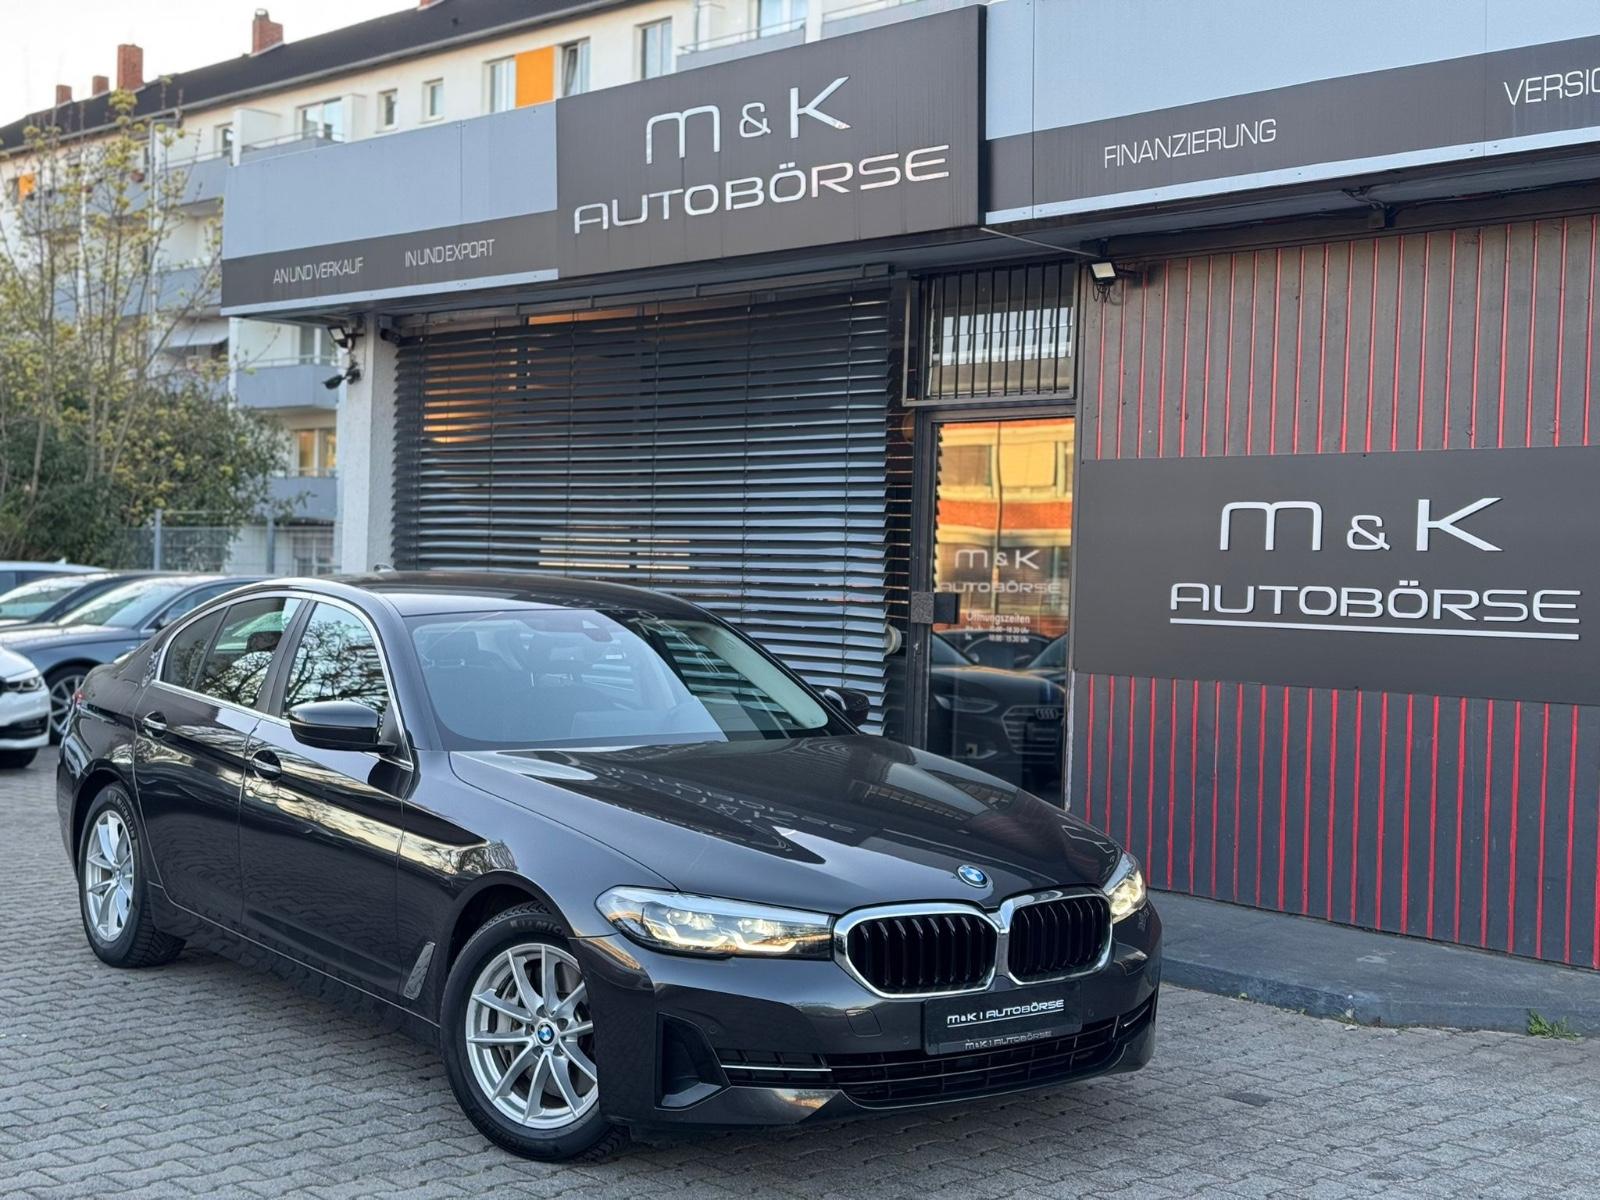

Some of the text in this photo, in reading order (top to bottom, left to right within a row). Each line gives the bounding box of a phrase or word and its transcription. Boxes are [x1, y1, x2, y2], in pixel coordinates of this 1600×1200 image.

[646, 76, 852, 165] M & K
[1104, 119, 1277, 169] FINANZIERUNG
[574, 144, 950, 235] AUTOBÖRSE
[1220, 497, 1503, 552] M & K
[955, 548, 1040, 570] M & K
[940, 580, 1061, 594] AUTOBÖRSE
[1170, 579, 1582, 624] AUTOBÖRSE
[986, 999, 1065, 1019] AUTOBÖRSE
[993, 1031, 1053, 1048] AUTOBÖRSE
